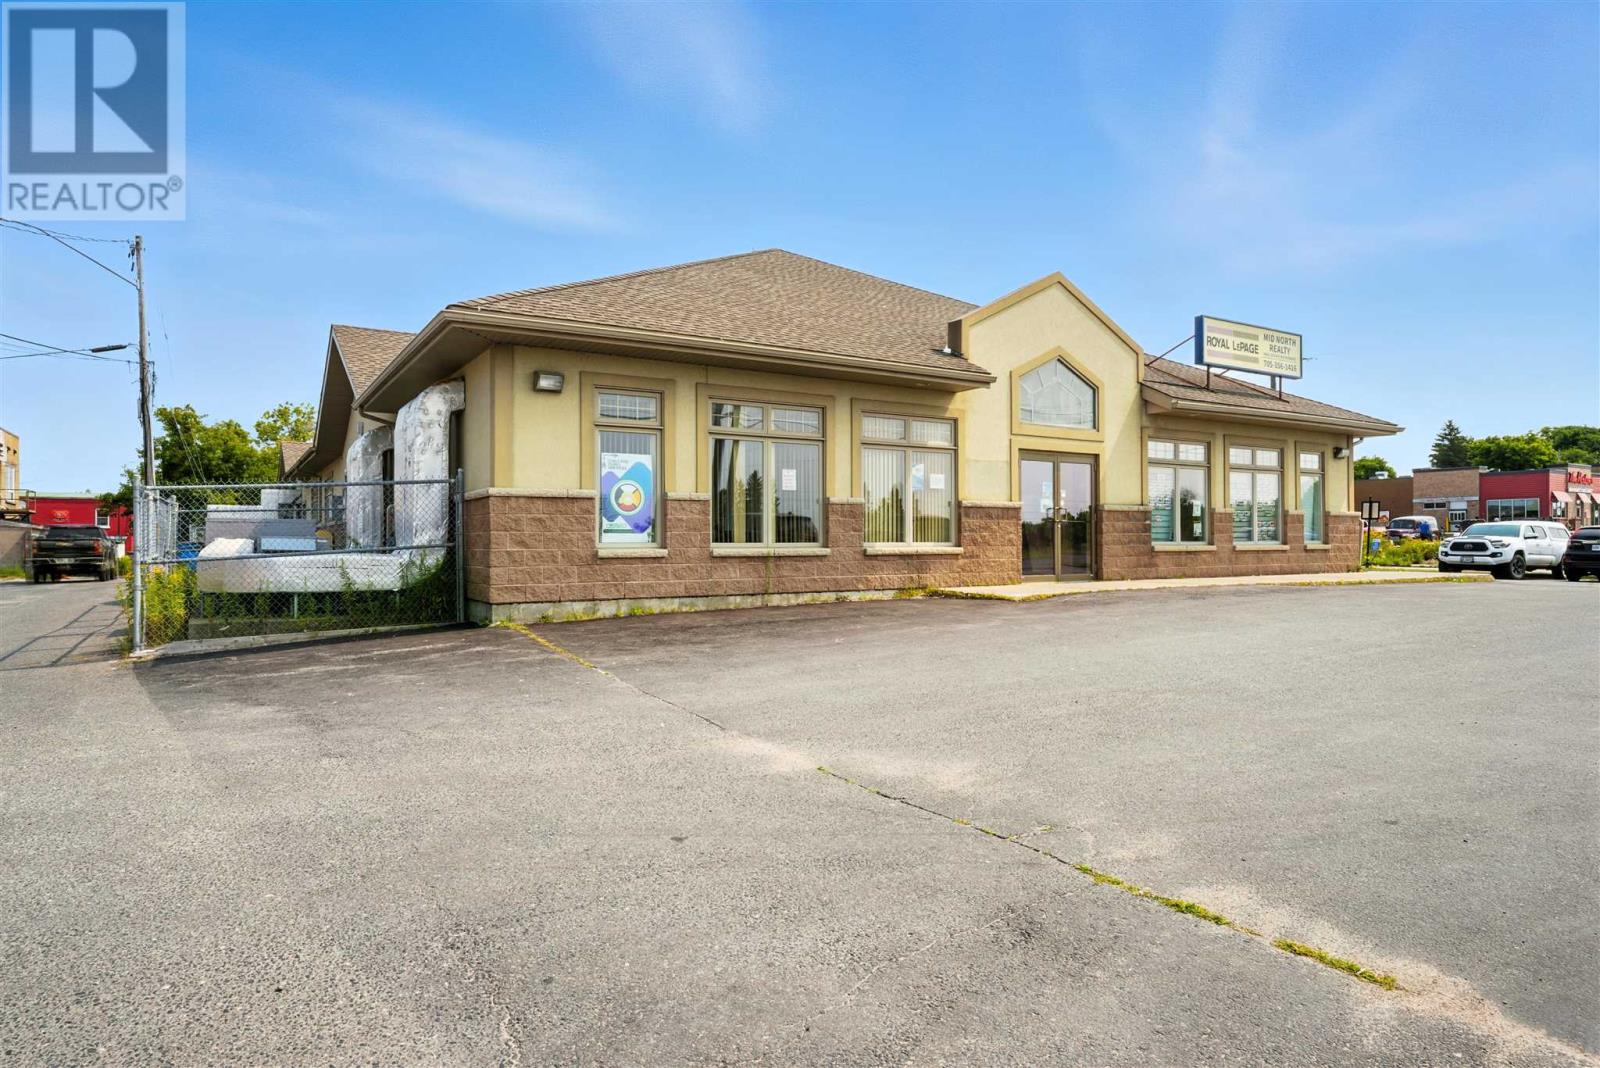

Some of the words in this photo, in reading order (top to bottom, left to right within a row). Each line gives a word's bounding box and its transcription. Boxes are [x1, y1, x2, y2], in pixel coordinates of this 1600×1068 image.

[1206, 336, 1230, 349] ROYAL
[1263, 334, 1275, 343] MID
[1276, 336, 1297, 347] NORTH
[1269, 344, 1290, 355] REALTY
